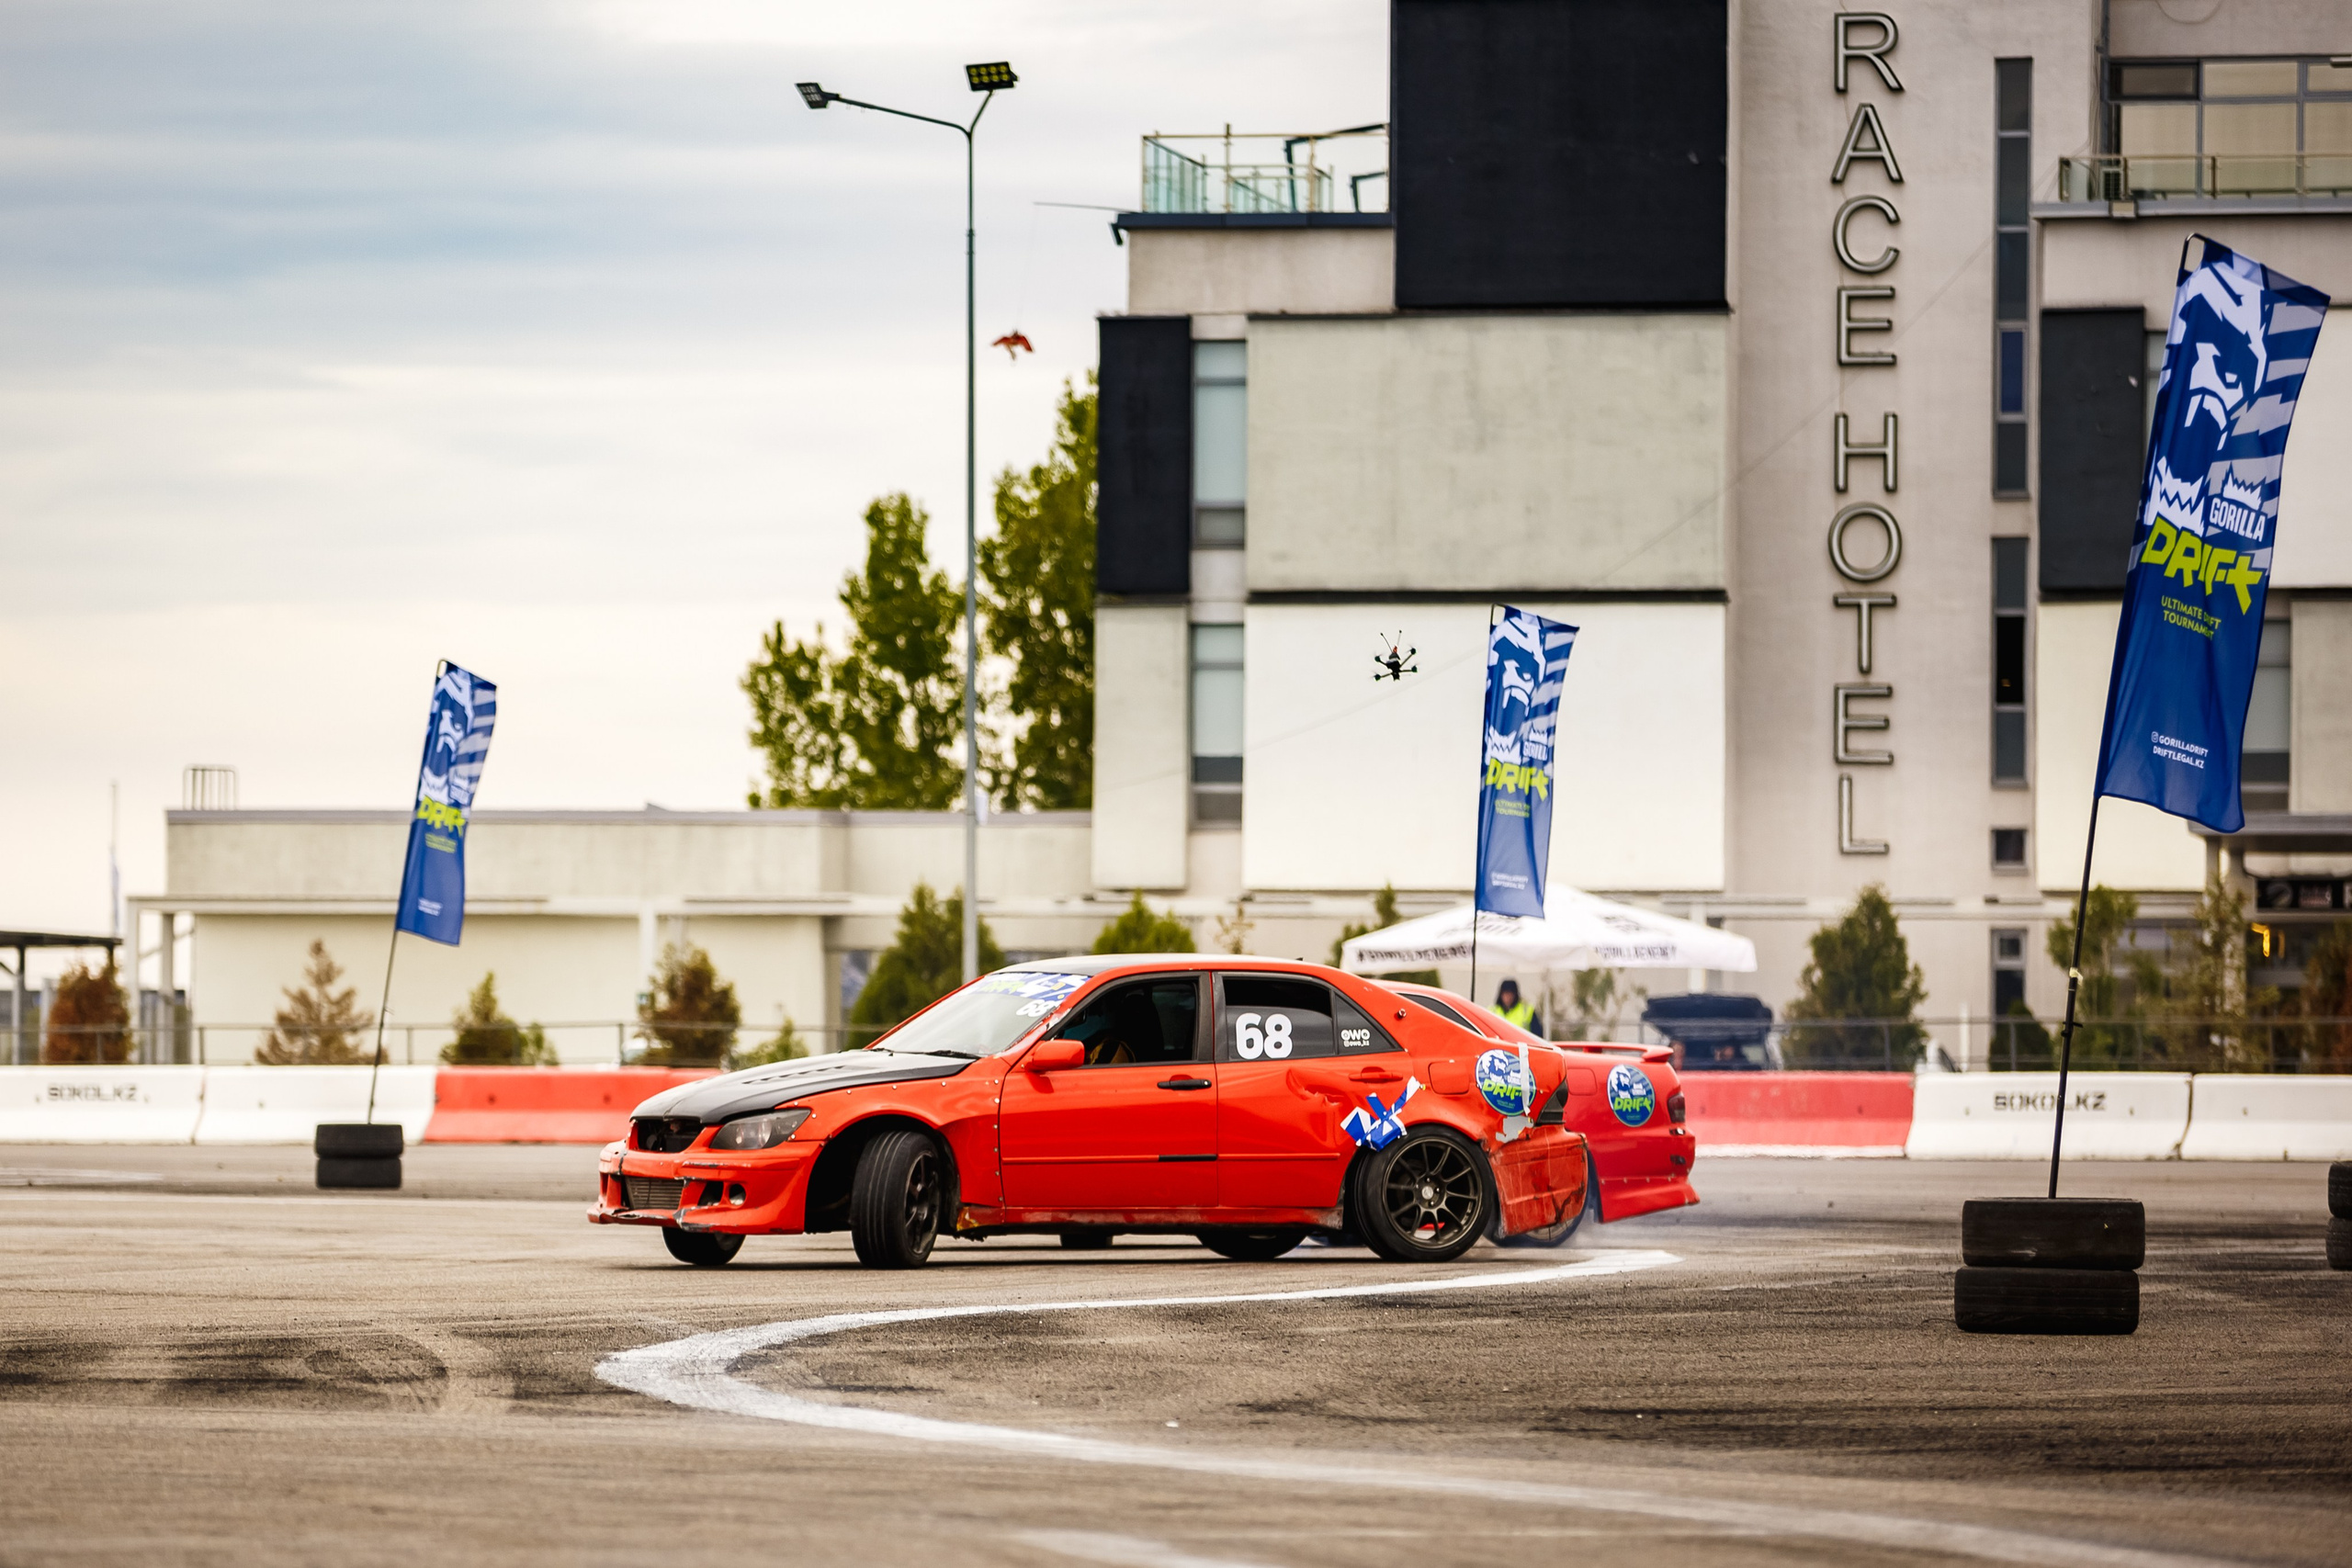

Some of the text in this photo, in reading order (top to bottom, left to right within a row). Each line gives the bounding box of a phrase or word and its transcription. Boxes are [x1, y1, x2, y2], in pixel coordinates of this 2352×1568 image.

[1827, 12, 1905, 855] RACE HOTEL
[2209, 497, 2267, 542] GORILLA
[2140, 516, 2263, 616] DRIFT
[2161, 595, 2202, 620] ULTIMATE
[1486, 757, 1549, 802] DRIFT
[2153, 745, 2205, 769] DRIFTLEGAL.KZ
[1236, 1012, 1293, 1060] 68
[1482, 1078, 1523, 1100] DRIF
[1614, 1097, 1651, 1113] DRIFT
